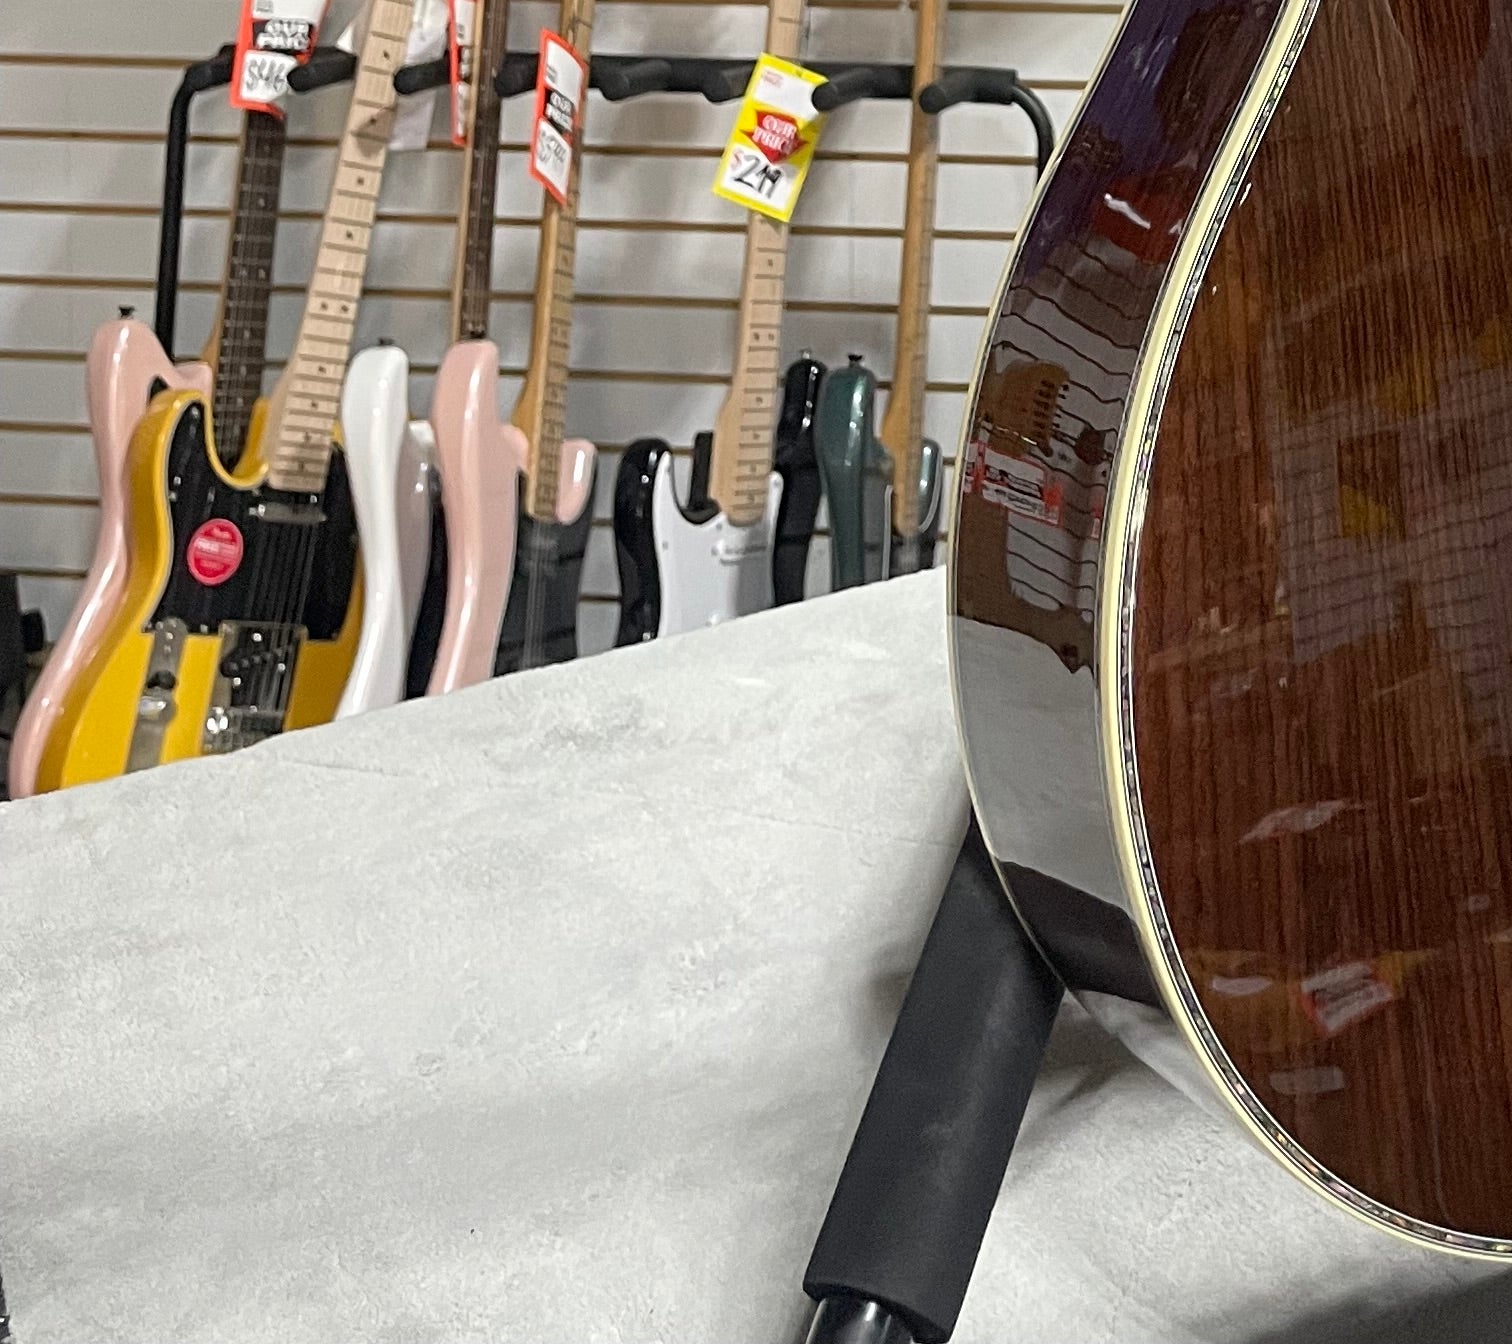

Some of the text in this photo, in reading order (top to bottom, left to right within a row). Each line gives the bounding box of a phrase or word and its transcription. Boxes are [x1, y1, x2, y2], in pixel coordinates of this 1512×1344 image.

[265, 18, 310, 38] OUR
[761, 114, 798, 140] OUR
[751, 126, 799, 156] PRICE
